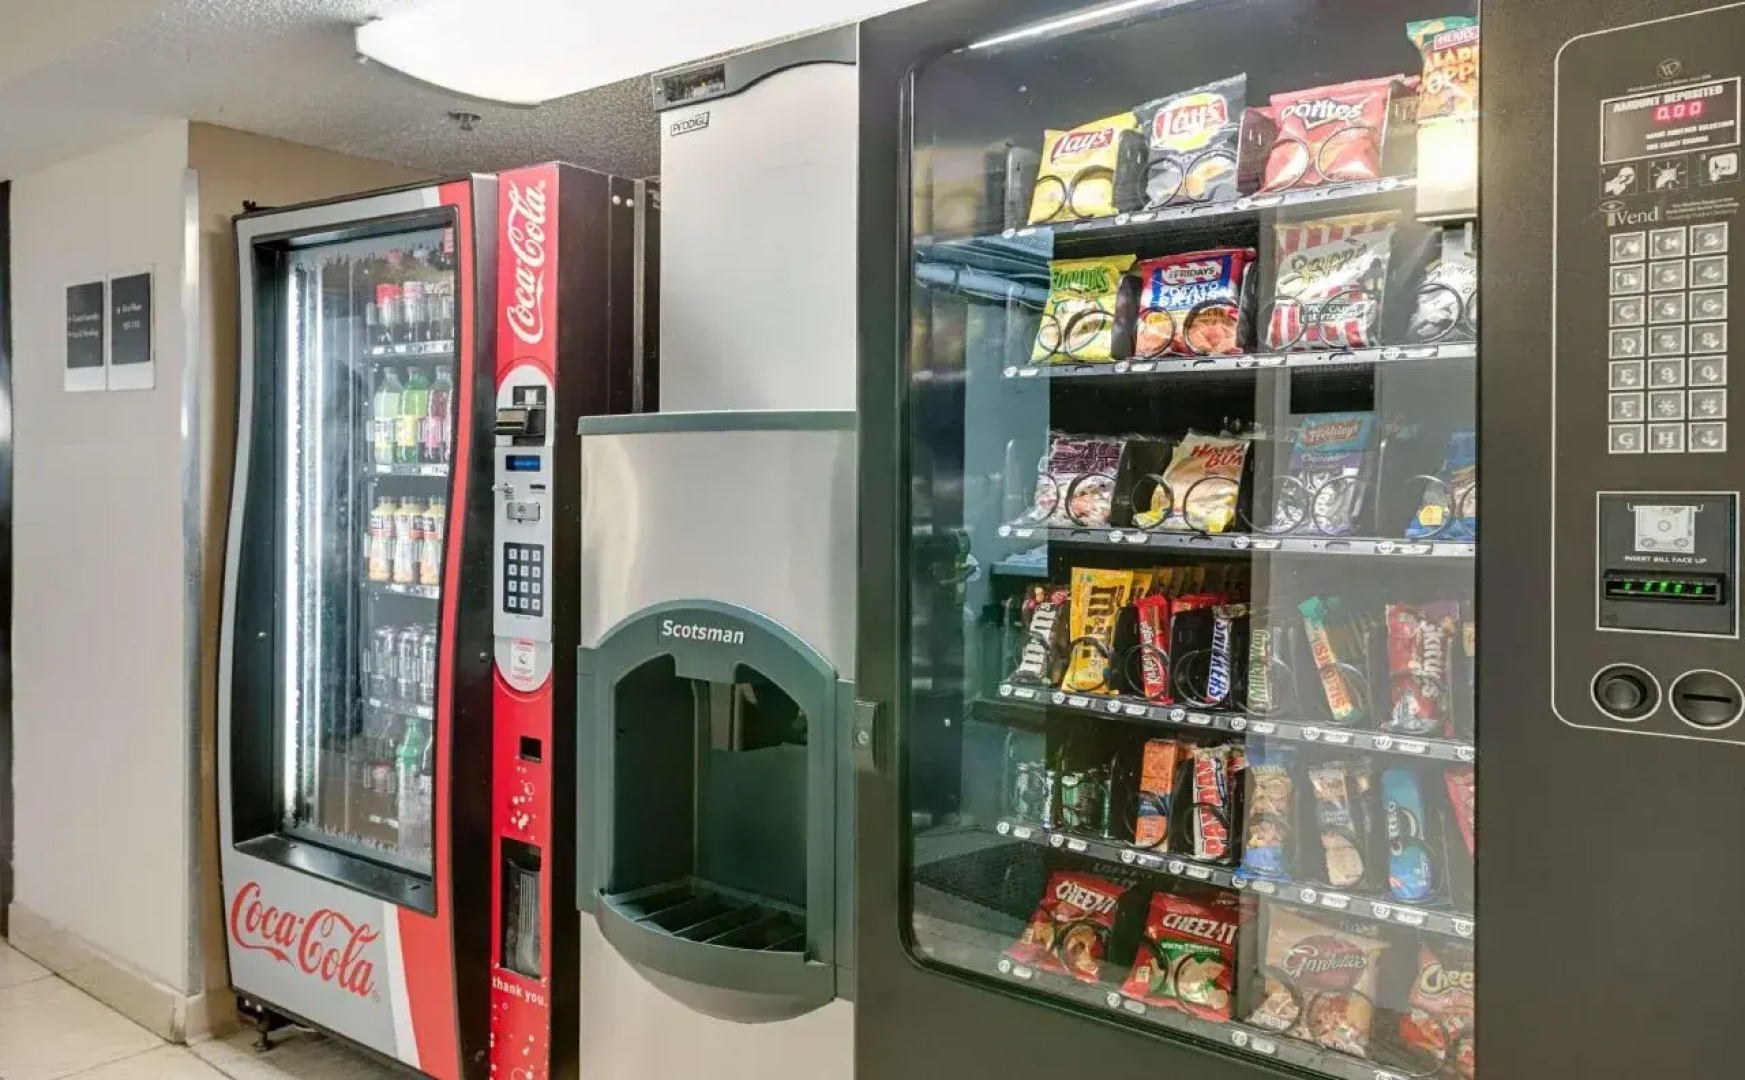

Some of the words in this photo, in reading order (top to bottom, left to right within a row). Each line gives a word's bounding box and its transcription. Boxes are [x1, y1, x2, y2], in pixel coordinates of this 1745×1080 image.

[1281, 98, 1364, 122] Doritos
[1613, 97, 1661, 113] AMOUNT
[1663, 85, 1724, 104] DEPOSITED
[1657, 101, 1702, 120] 0.00
[1163, 102, 1220, 137] Lay's
[1057, 130, 1112, 155] Lay's
[1600, 201, 1659, 227] iVend
[507, 180, 547, 344] Coca-Cola
[1174, 266, 1215, 279] FRIDAYS
[661, 619, 745, 645] Scotsman
[1207, 620, 1230, 697] SNICKERS
[1056, 880, 1119, 915] CHEEZ-IT
[231, 881, 381, 998] Coca-Cola
[1162, 913, 1238, 945] CHEEZ-IT
[493, 977, 523, 999] thank
[524, 988, 548, 1007] you.
[1420, 963, 1475, 994] Chee
